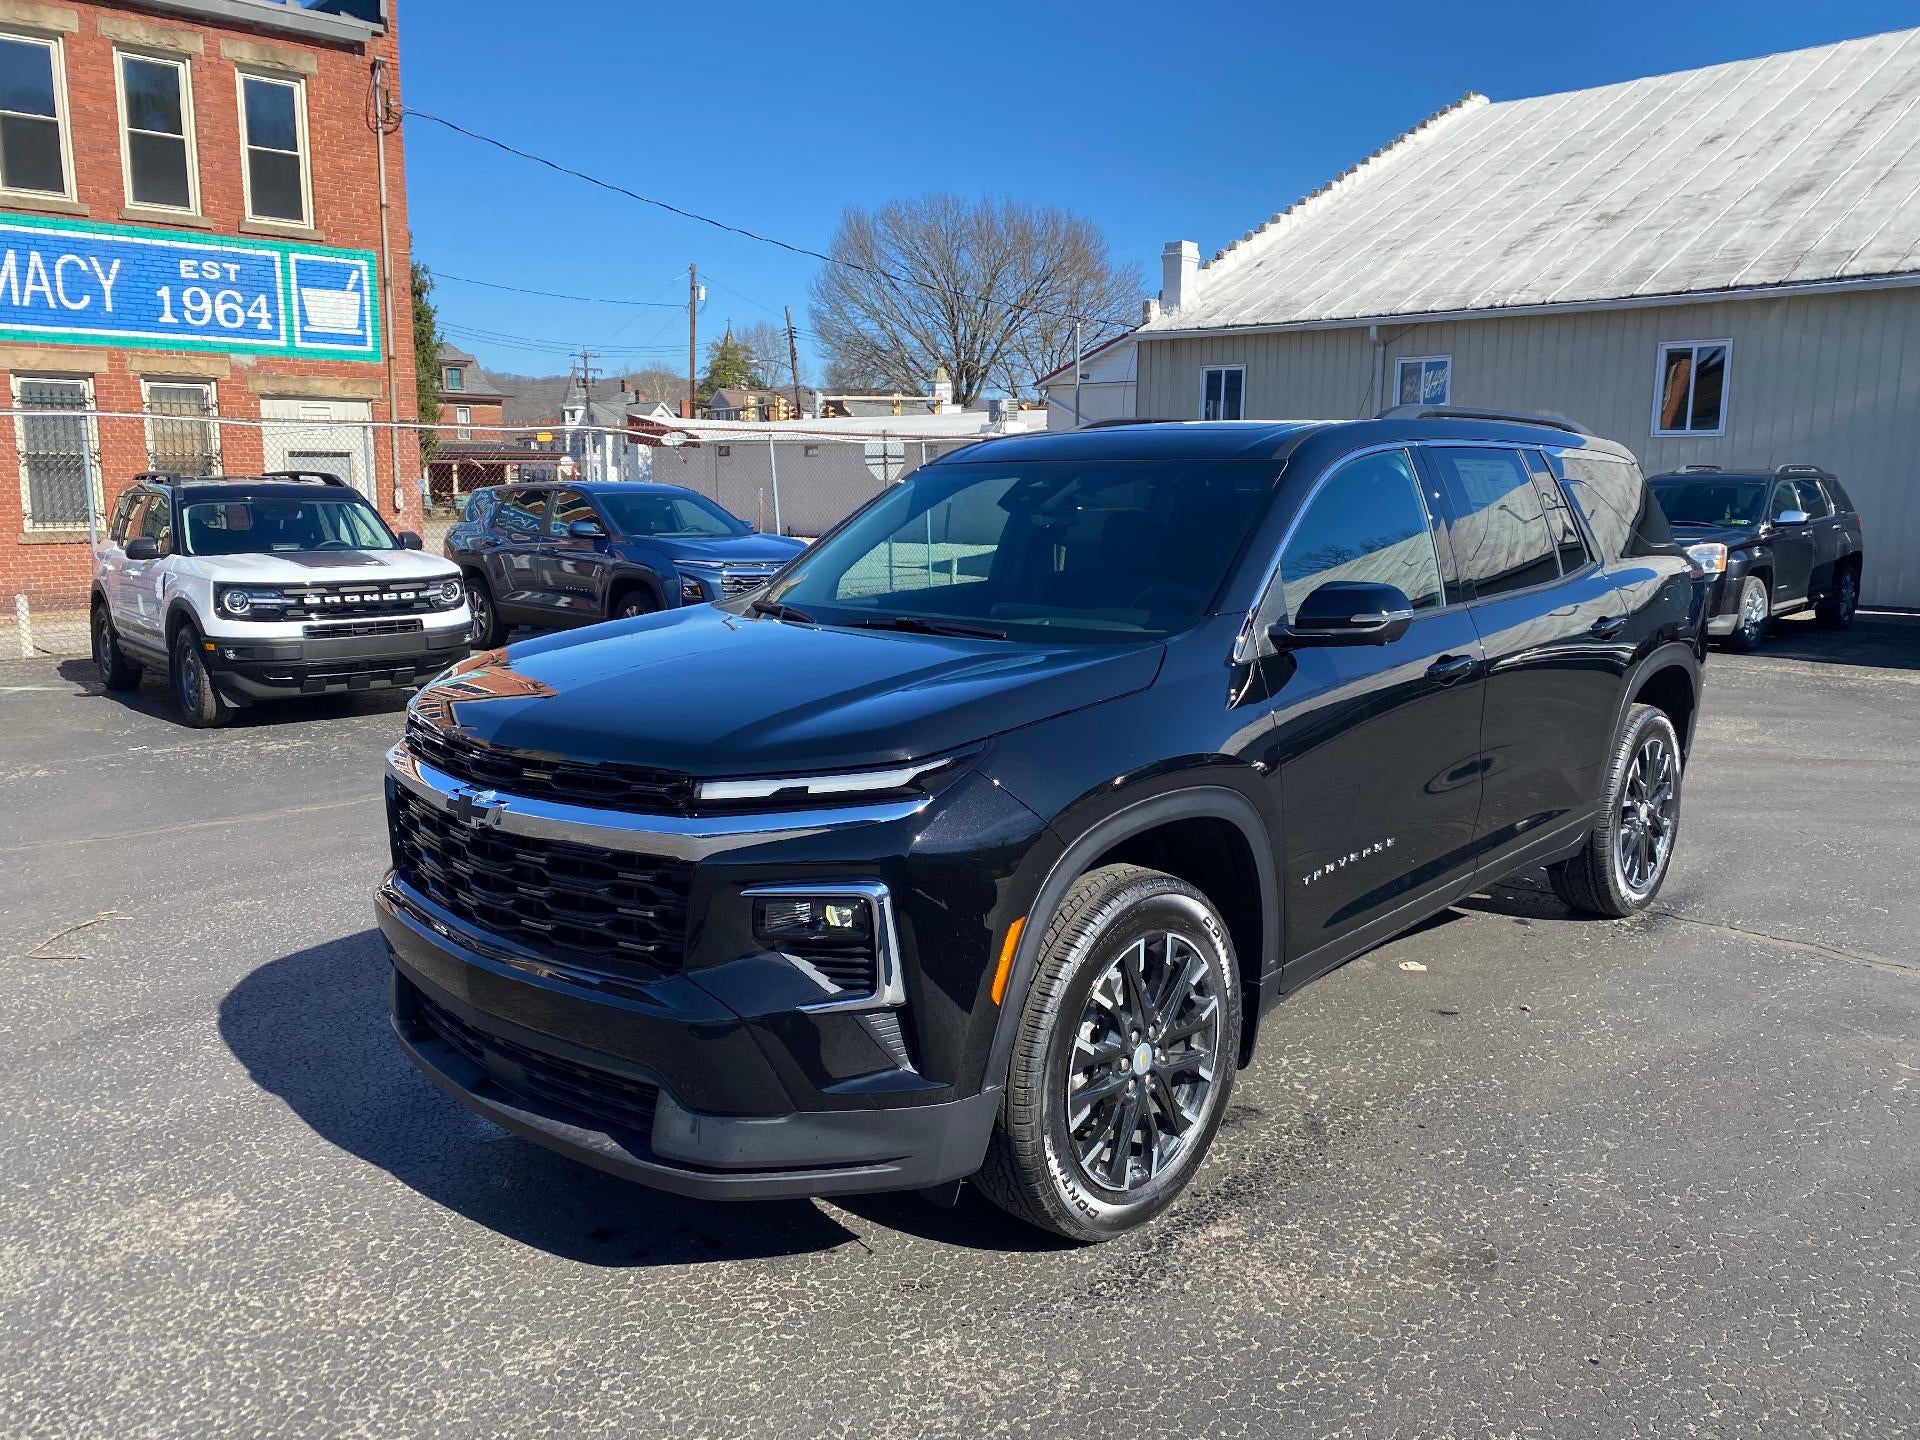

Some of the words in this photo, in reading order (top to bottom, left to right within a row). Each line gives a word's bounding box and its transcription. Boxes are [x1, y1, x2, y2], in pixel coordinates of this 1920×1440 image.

[180, 259, 241, 283] EST
[156, 285, 273, 331] 1964
[303, 591, 416, 604] BRONCO
